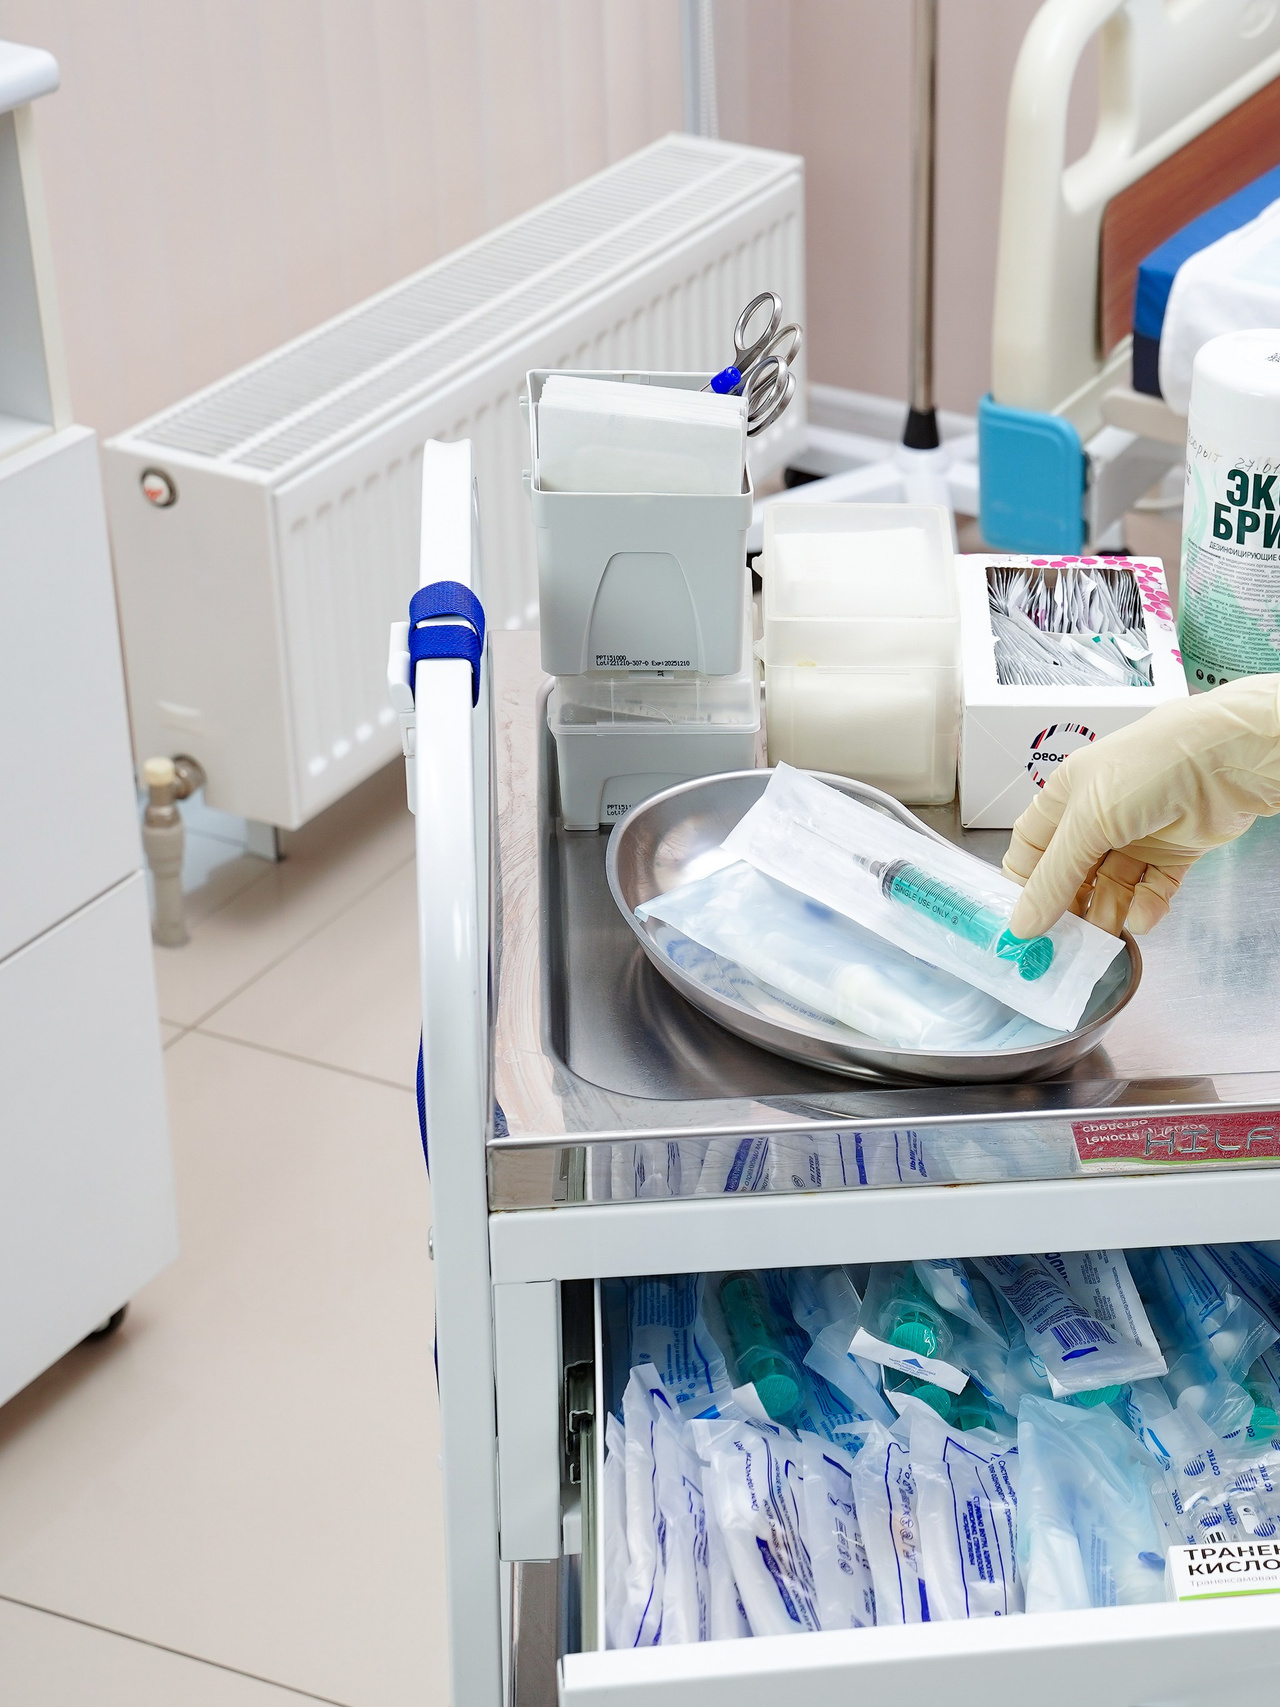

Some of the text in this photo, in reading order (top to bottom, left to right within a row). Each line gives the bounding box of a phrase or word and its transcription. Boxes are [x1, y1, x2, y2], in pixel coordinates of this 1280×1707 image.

[1209, 541, 1278, 562] ДЕЗИНФИЦИРУЮЩИЕ
[894, 884, 950, 919] SINGLE USE ONLY
[1189, 1574, 1278, 1588] Транексамовая
